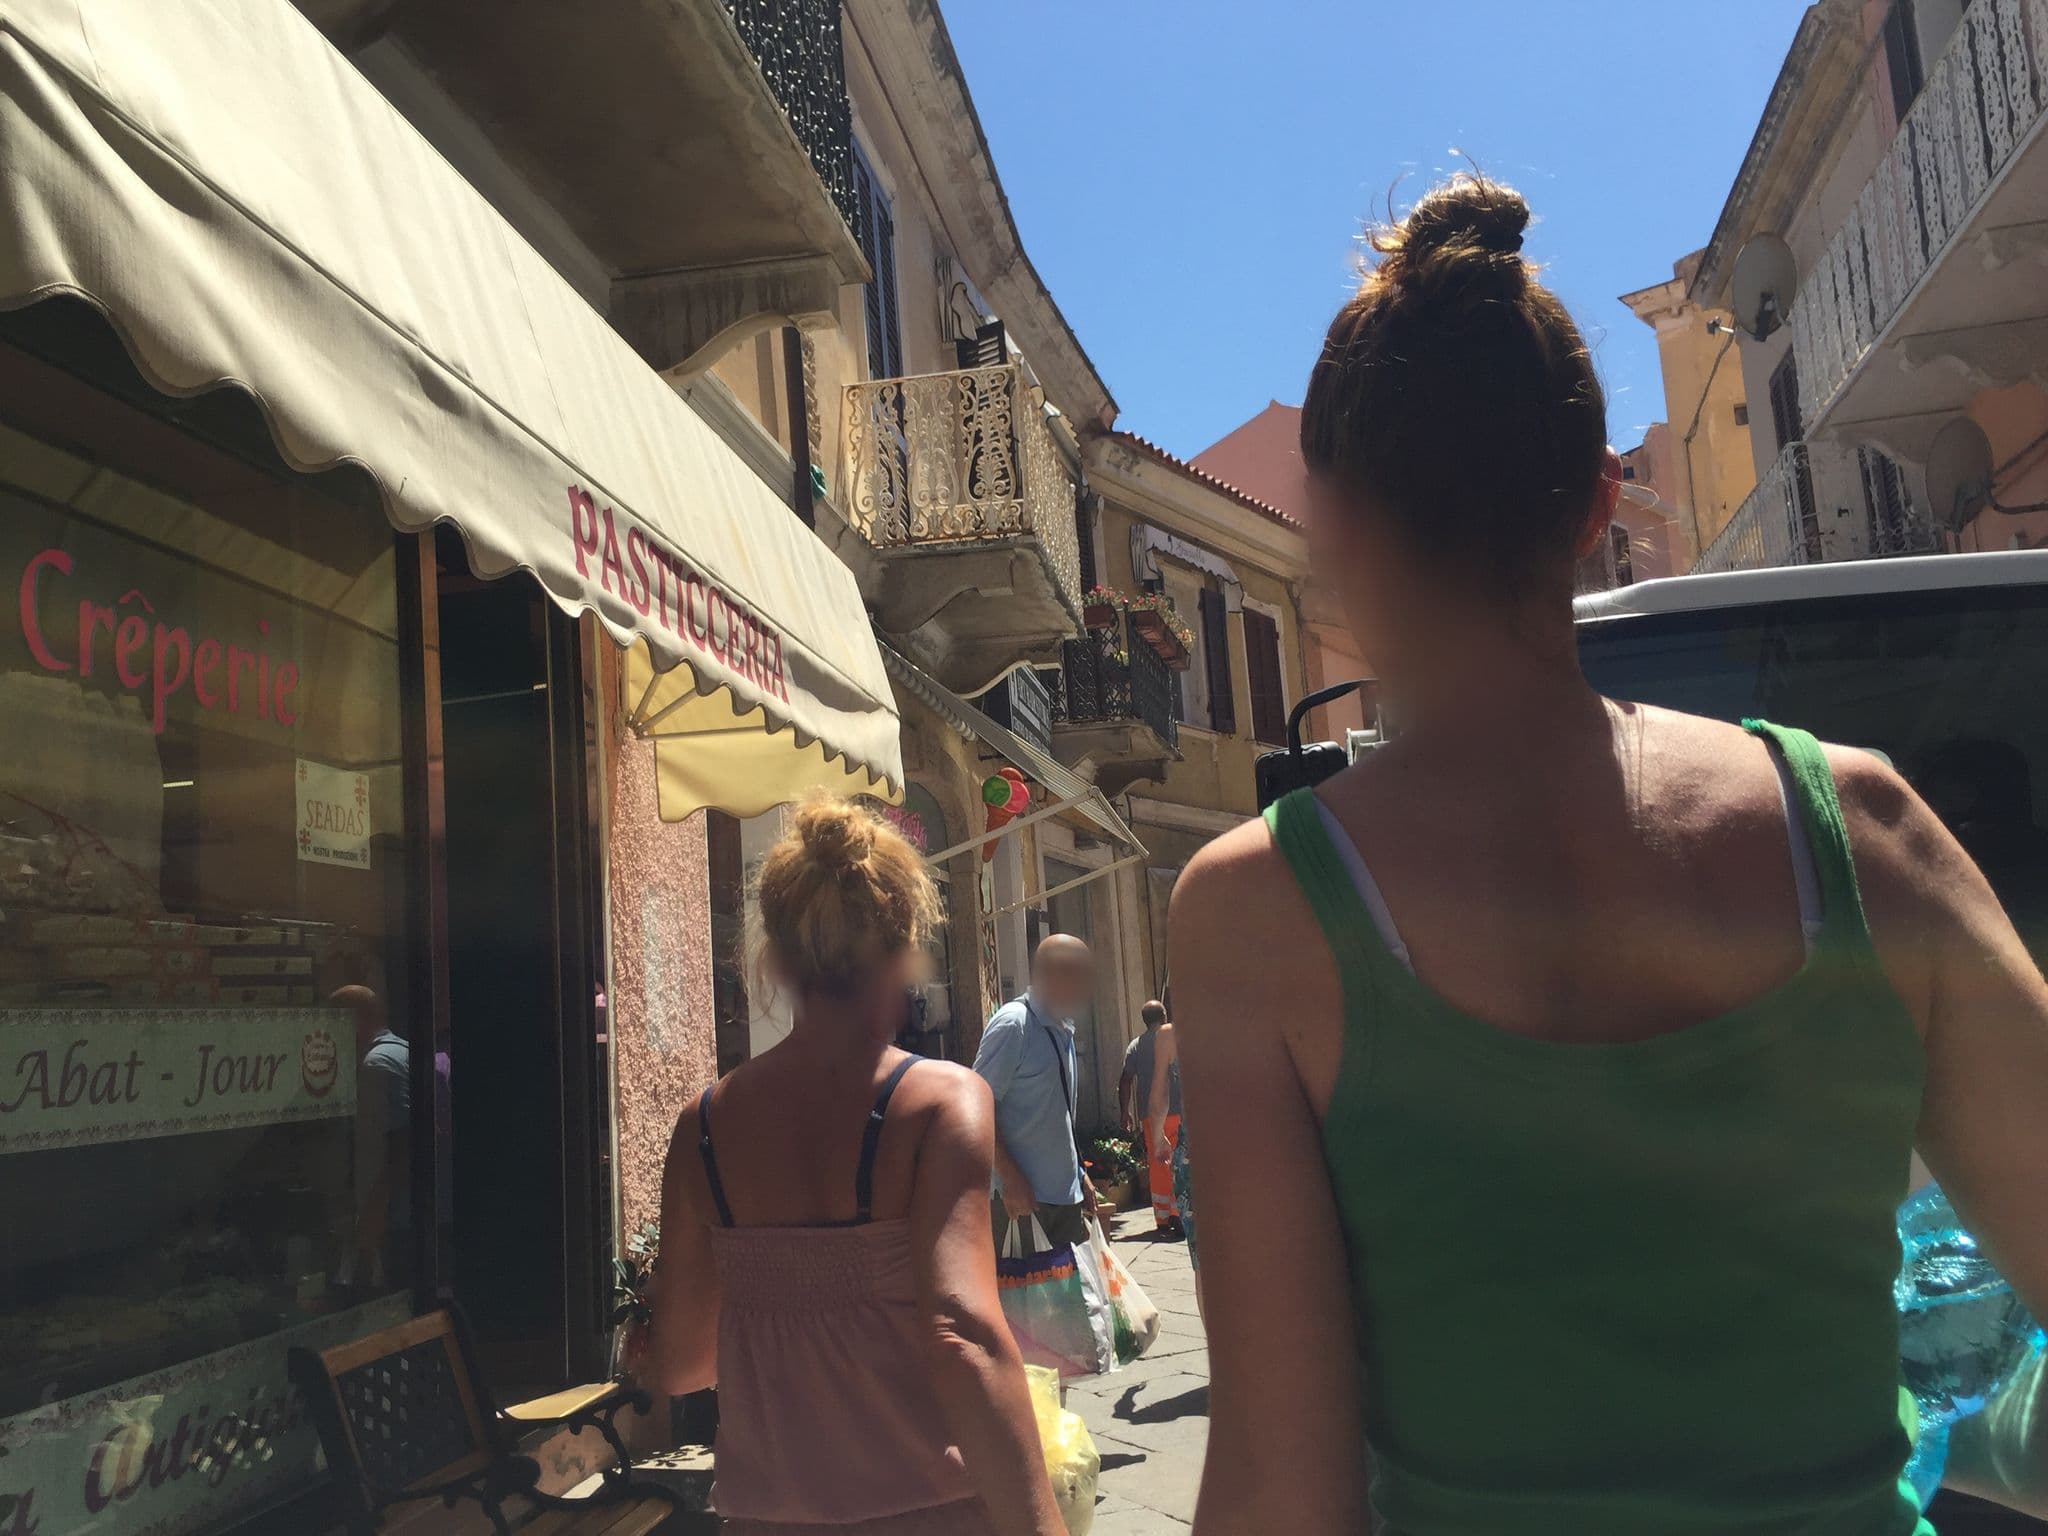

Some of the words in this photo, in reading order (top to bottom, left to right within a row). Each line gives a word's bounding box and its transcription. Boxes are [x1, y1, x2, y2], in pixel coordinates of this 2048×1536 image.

[19, 548, 300, 734] Crêperie
[567, 484, 790, 704] PASTICCERIA
[305, 799, 365, 838] SEADAS
[0, 1038, 145, 1113] Abat
[183, 1044, 289, 1109] Jour
